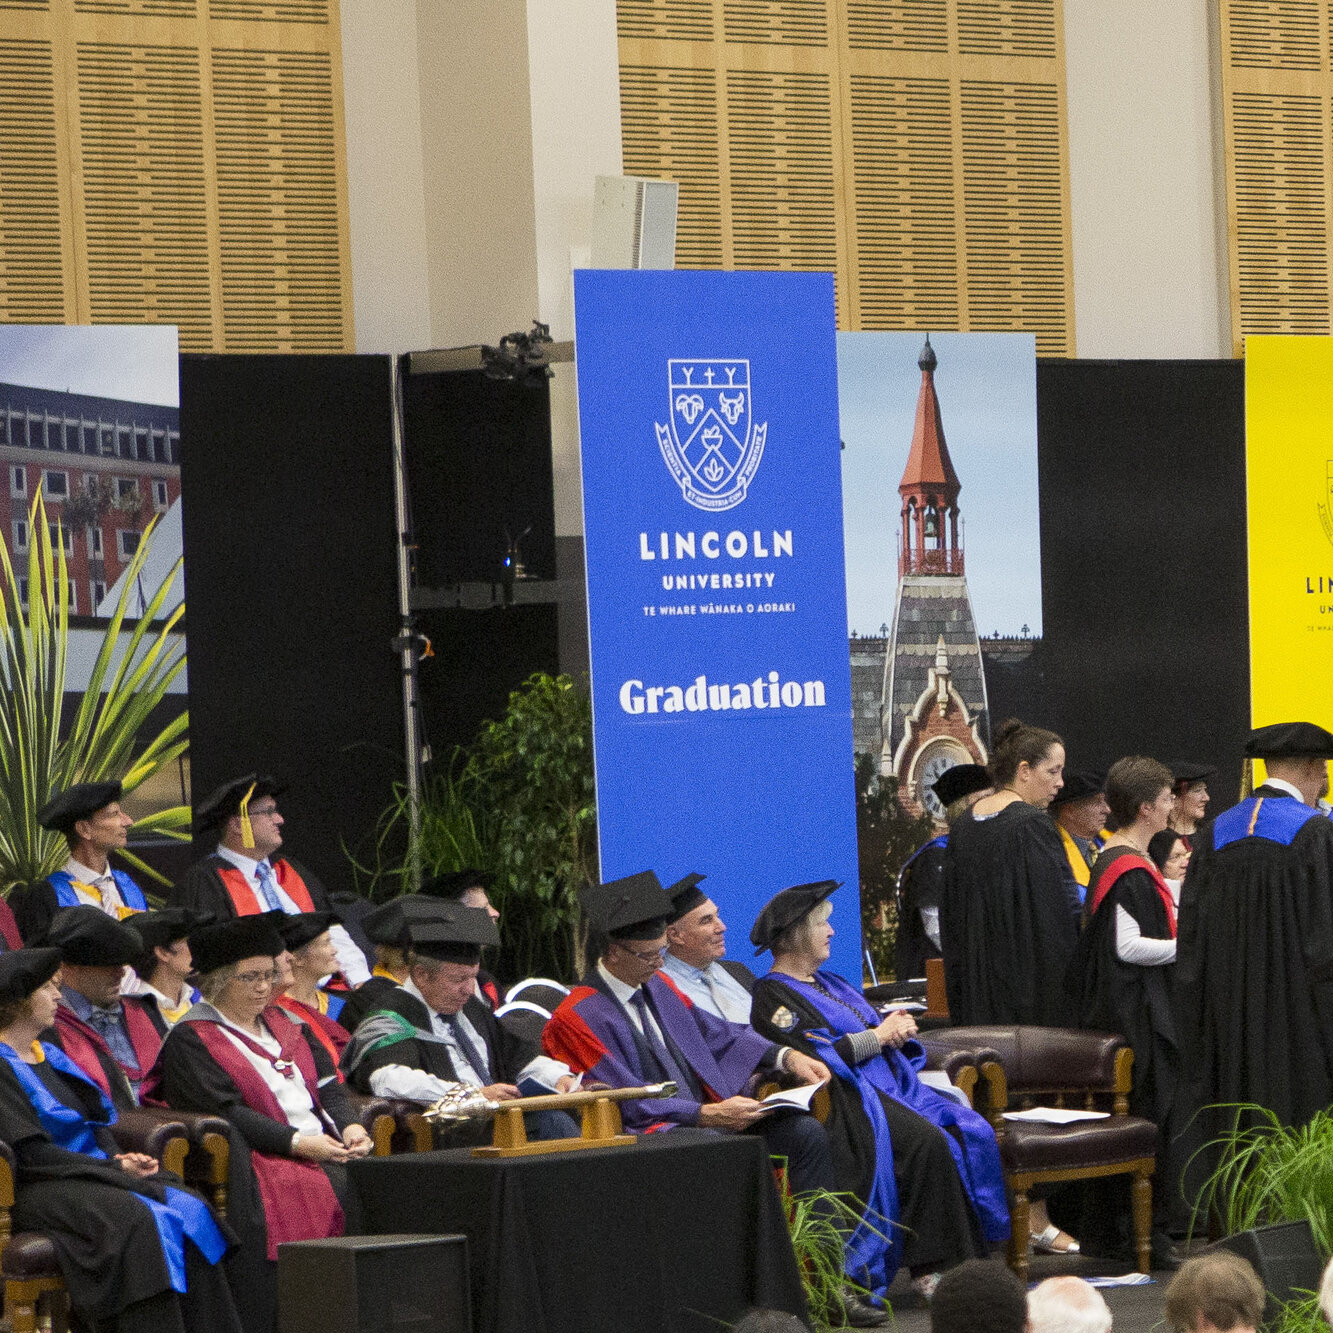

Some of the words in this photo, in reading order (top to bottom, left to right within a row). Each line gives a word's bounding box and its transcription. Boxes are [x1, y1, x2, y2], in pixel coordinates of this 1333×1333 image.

[639, 530, 793, 561] LINCOLN
[662, 572, 775, 590] UNIVERSITY
[643, 606, 656, 616] TE
[659, 605, 697, 615] WHARE
[746, 604, 755, 613] O
[757, 602, 796, 613] AORAKI
[619, 671, 826, 714] Graduation
